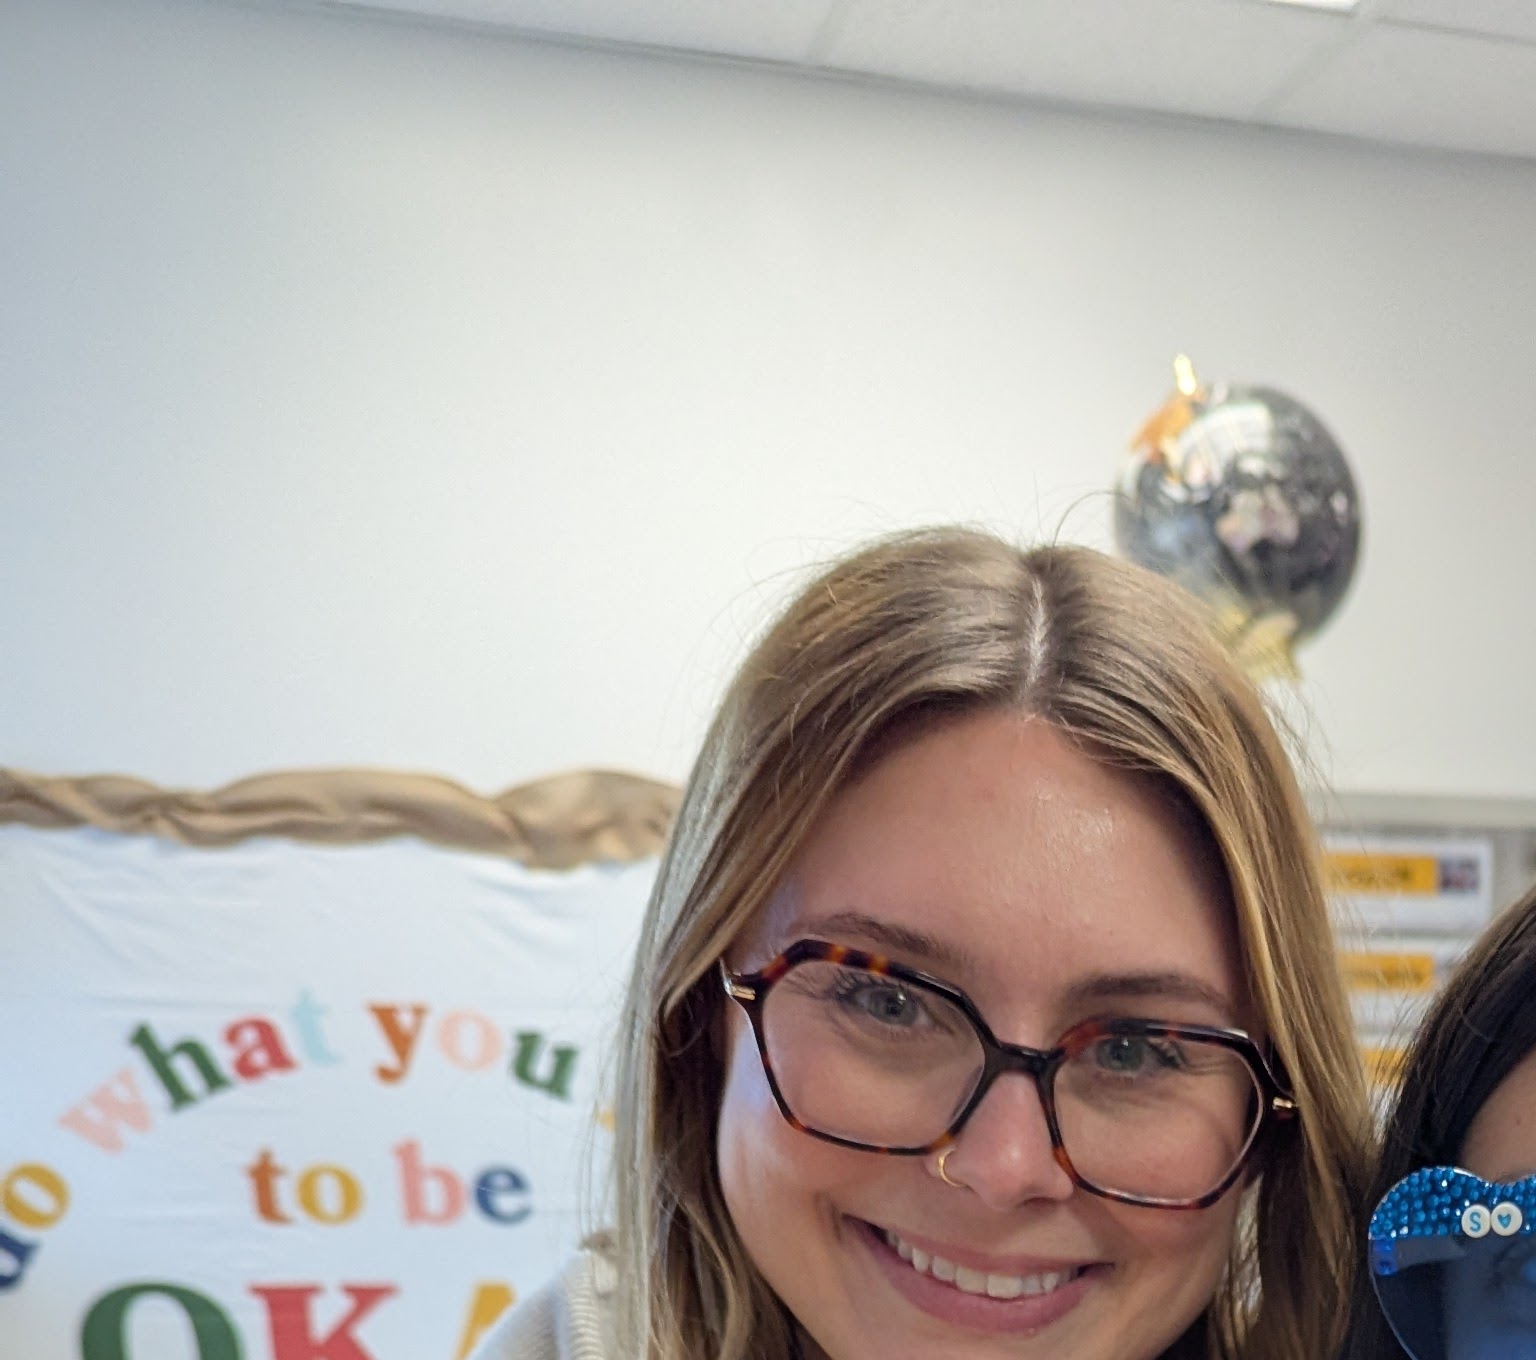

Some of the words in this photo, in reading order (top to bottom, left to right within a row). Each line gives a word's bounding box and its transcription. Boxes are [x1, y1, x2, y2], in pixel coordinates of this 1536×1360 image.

[57, 987, 342, 1155] what
[368, 1001, 581, 1103] you
[246, 1149, 364, 1225] to
[394, 1139, 533, 1225] be
